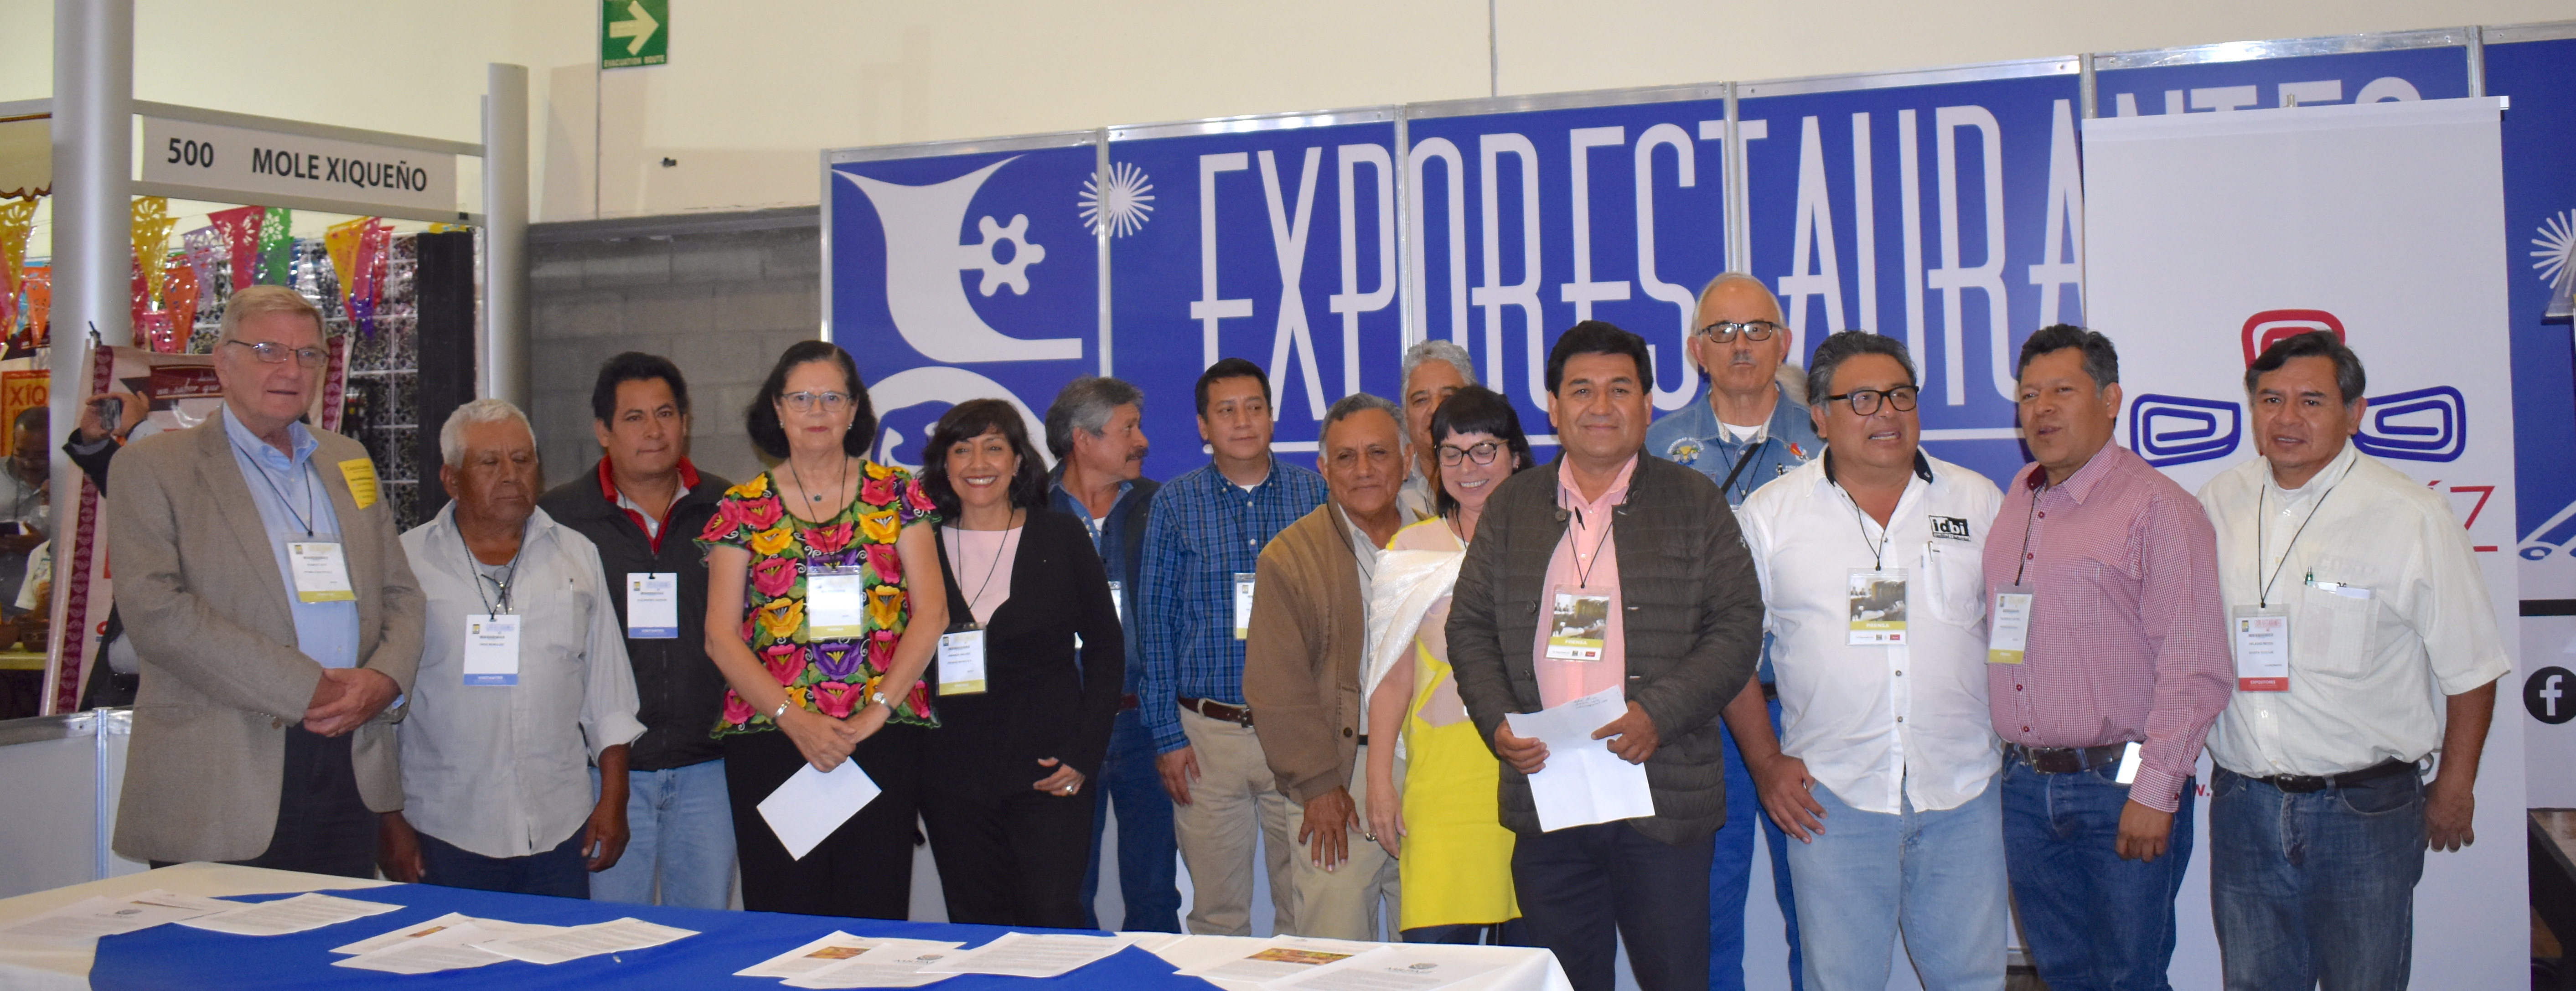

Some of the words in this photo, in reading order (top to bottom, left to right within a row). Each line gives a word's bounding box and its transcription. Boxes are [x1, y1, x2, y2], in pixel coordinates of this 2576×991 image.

[167, 137, 214, 168] 500
[252, 147, 320, 180] MOLE
[326, 156, 427, 192] XIQUEÑO
[1191, 76, 2422, 420] EXPORESTAURA
